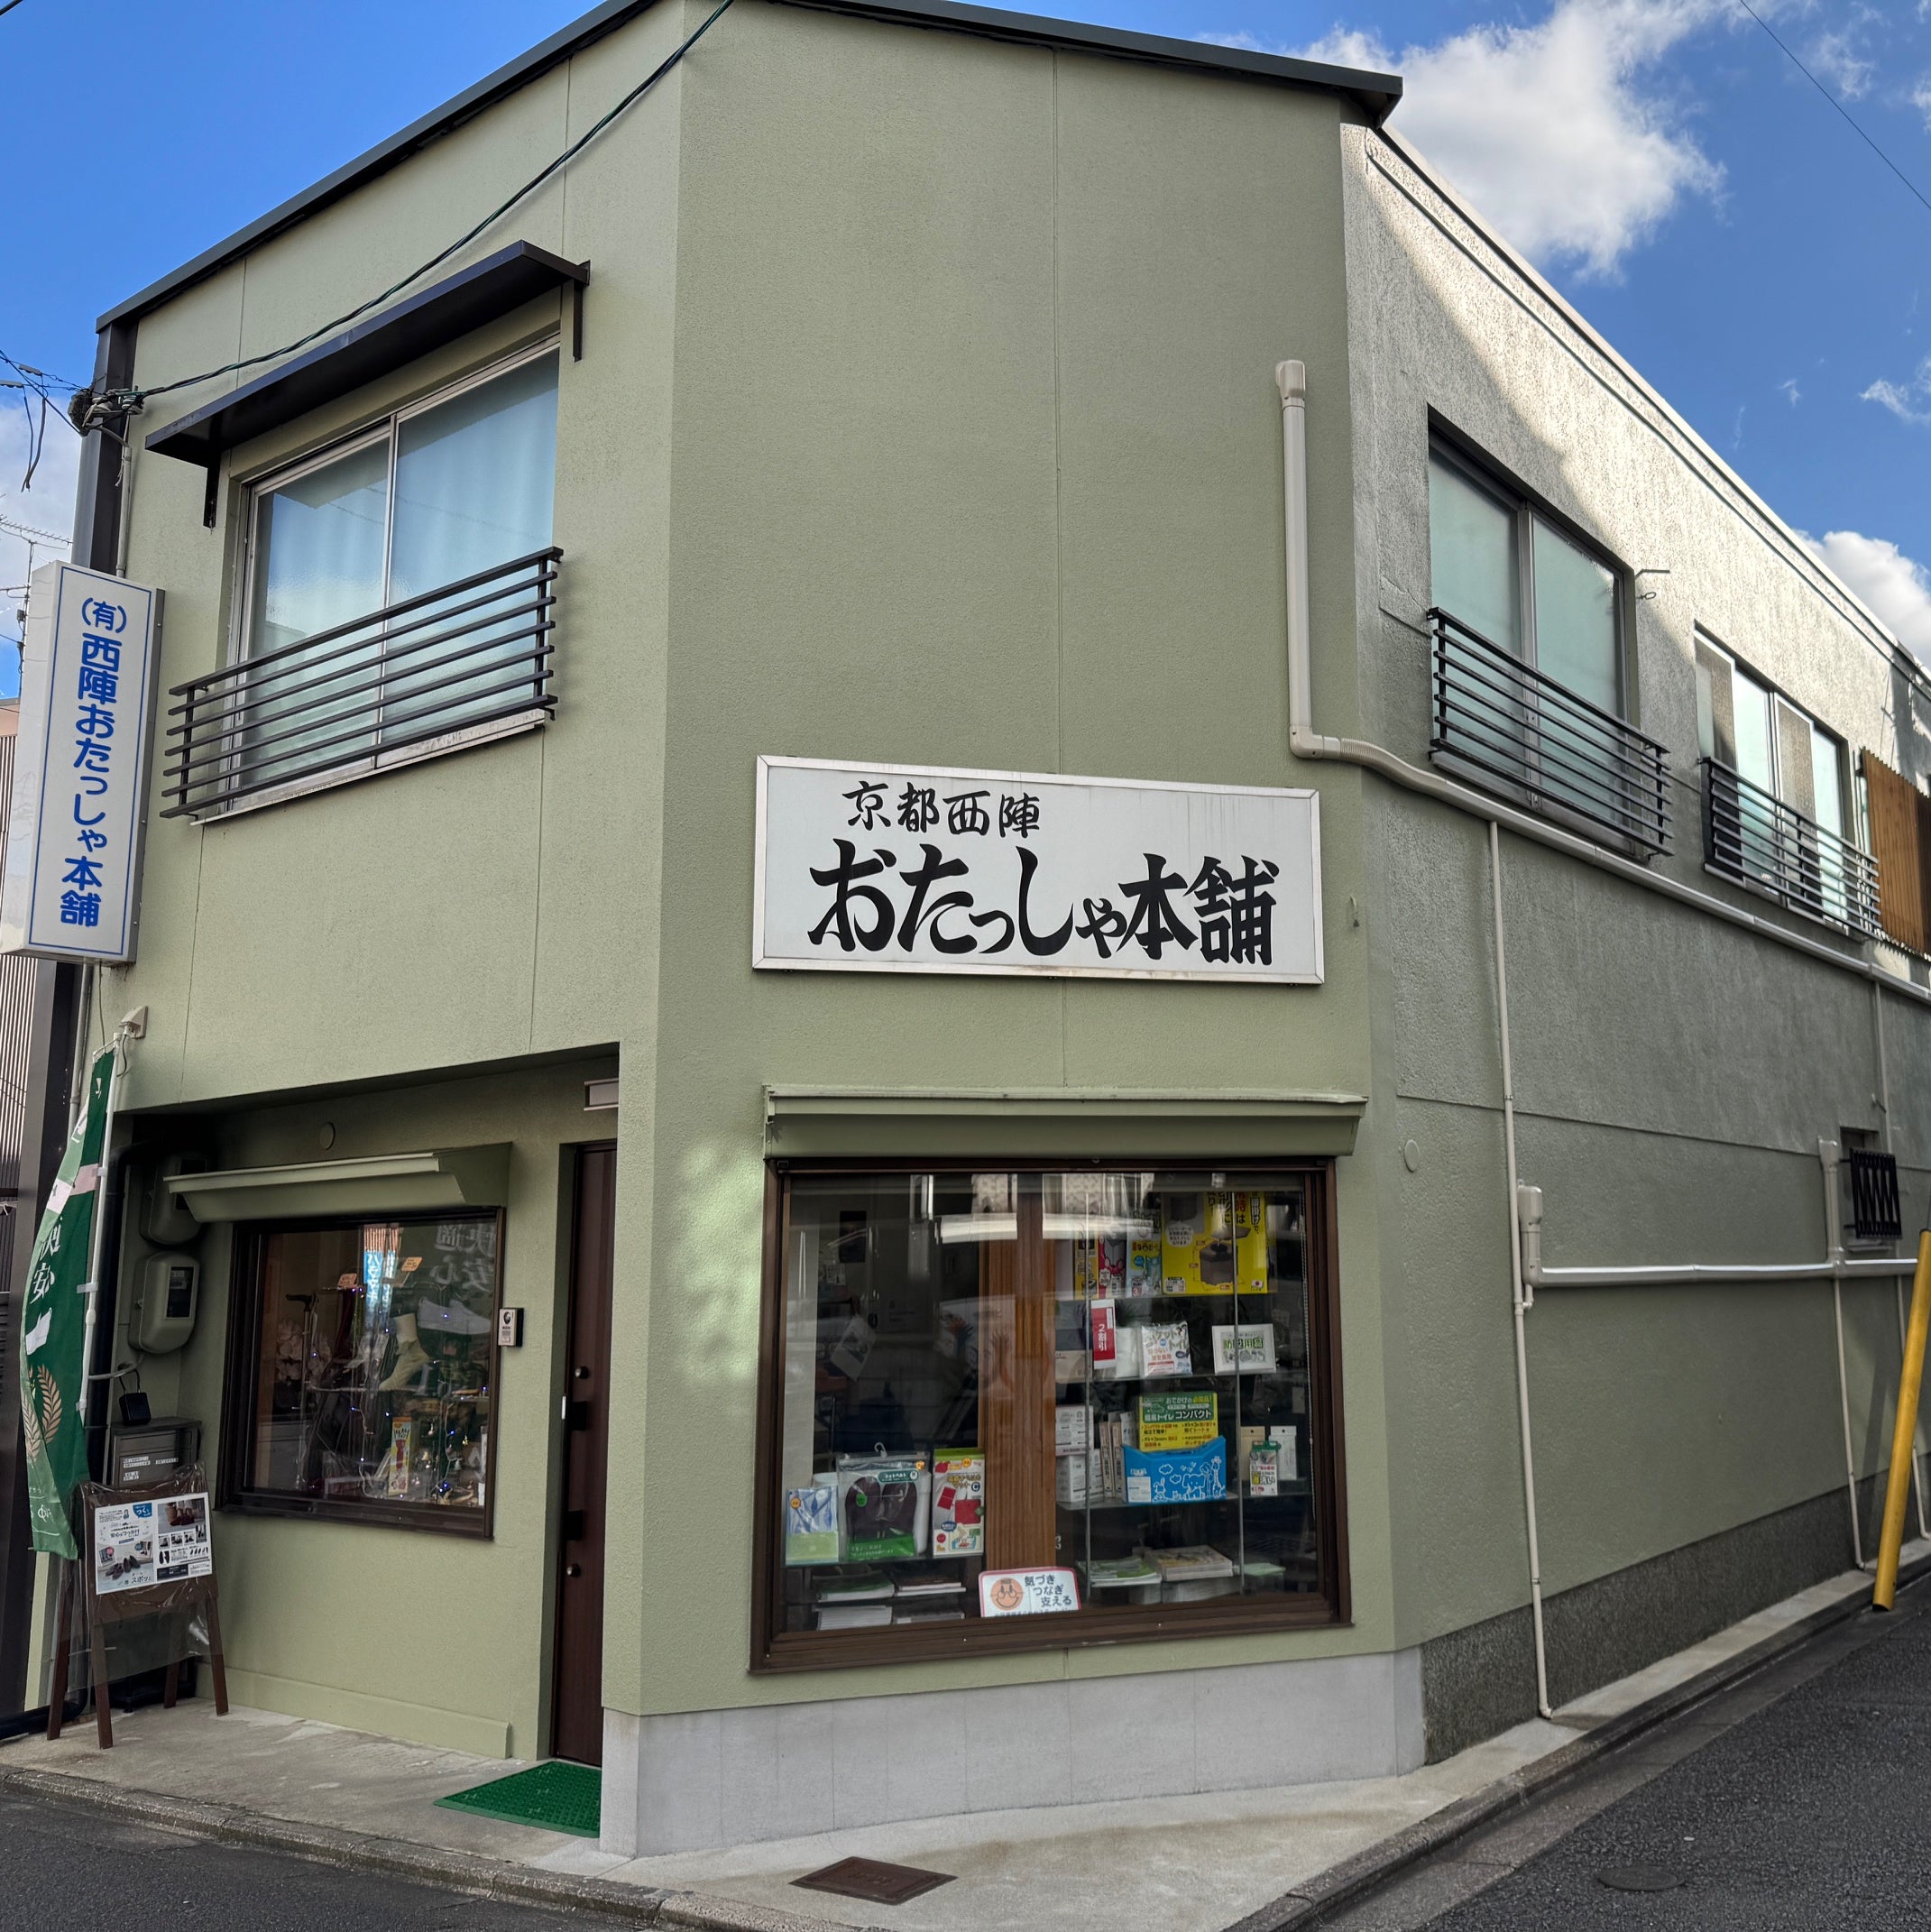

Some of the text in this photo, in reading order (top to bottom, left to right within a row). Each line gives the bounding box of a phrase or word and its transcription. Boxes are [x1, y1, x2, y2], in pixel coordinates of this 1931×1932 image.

[60, 597, 127, 927] (有)西陣おたっしゃ本舗
[841, 780, 1041, 838] 京都西陣
[808, 838, 1281, 966] おたっしゃ本舗
[1098, 1323, 1108, 1351] 2割引
[1175, 1409, 1211, 1420] コンパクト
[1025, 1574, 1055, 1587] 気づき
[1034, 1584, 1064, 1596] つなぎ
[1041, 1596, 1072, 1607] 支える
